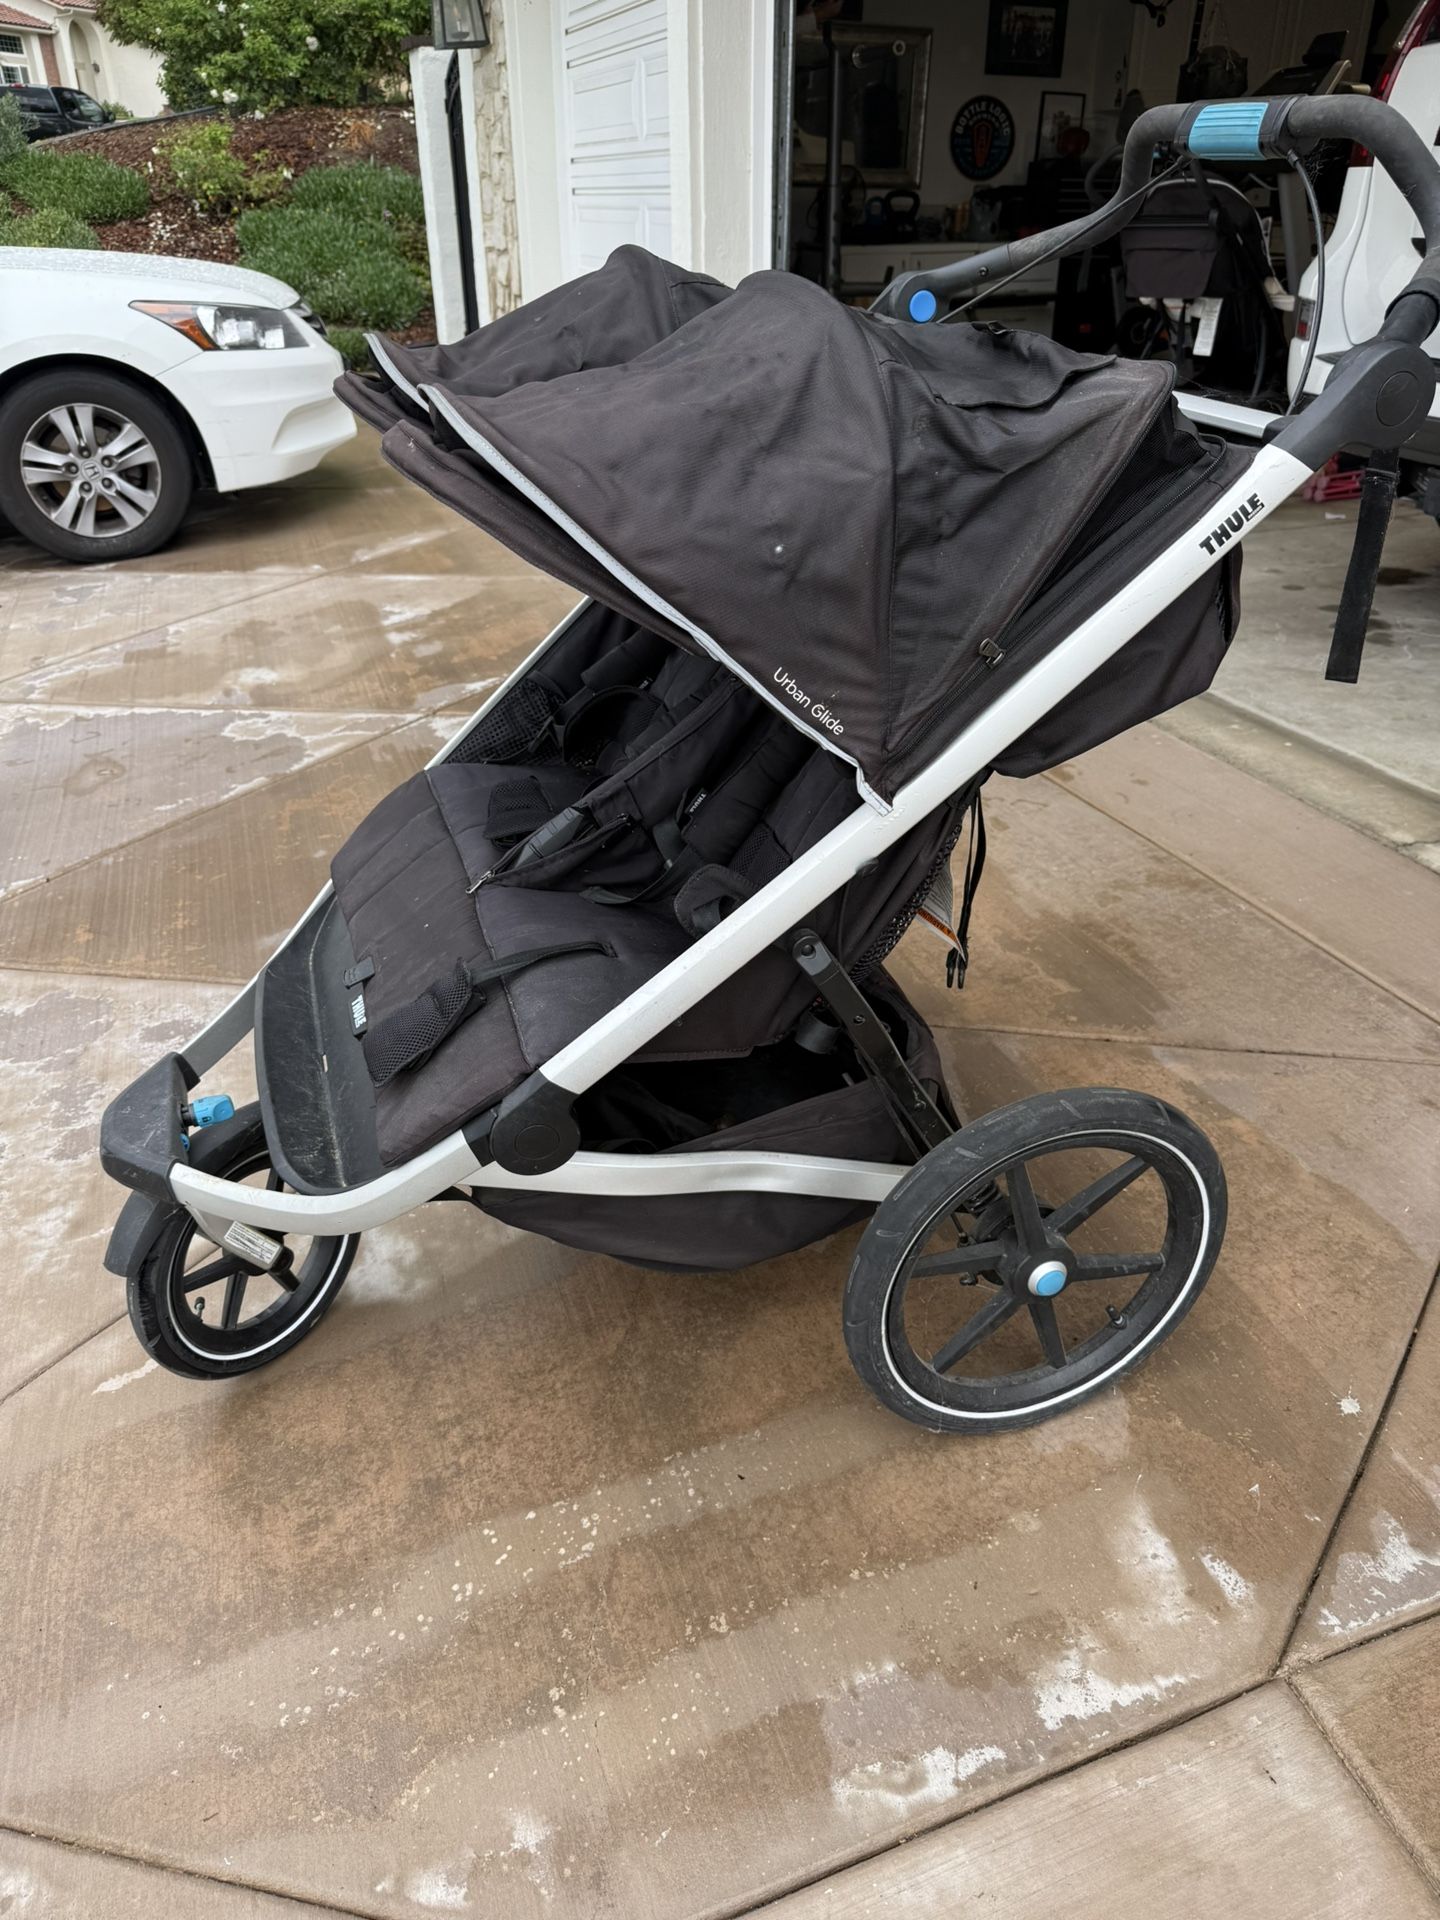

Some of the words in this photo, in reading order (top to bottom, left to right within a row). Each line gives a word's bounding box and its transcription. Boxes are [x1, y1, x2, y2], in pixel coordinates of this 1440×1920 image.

[1198, 493, 1265, 556] THULE
[773, 666, 811, 708] Urban
[811, 704, 844, 736] Glide
[351, 994, 367, 1029] THULE
